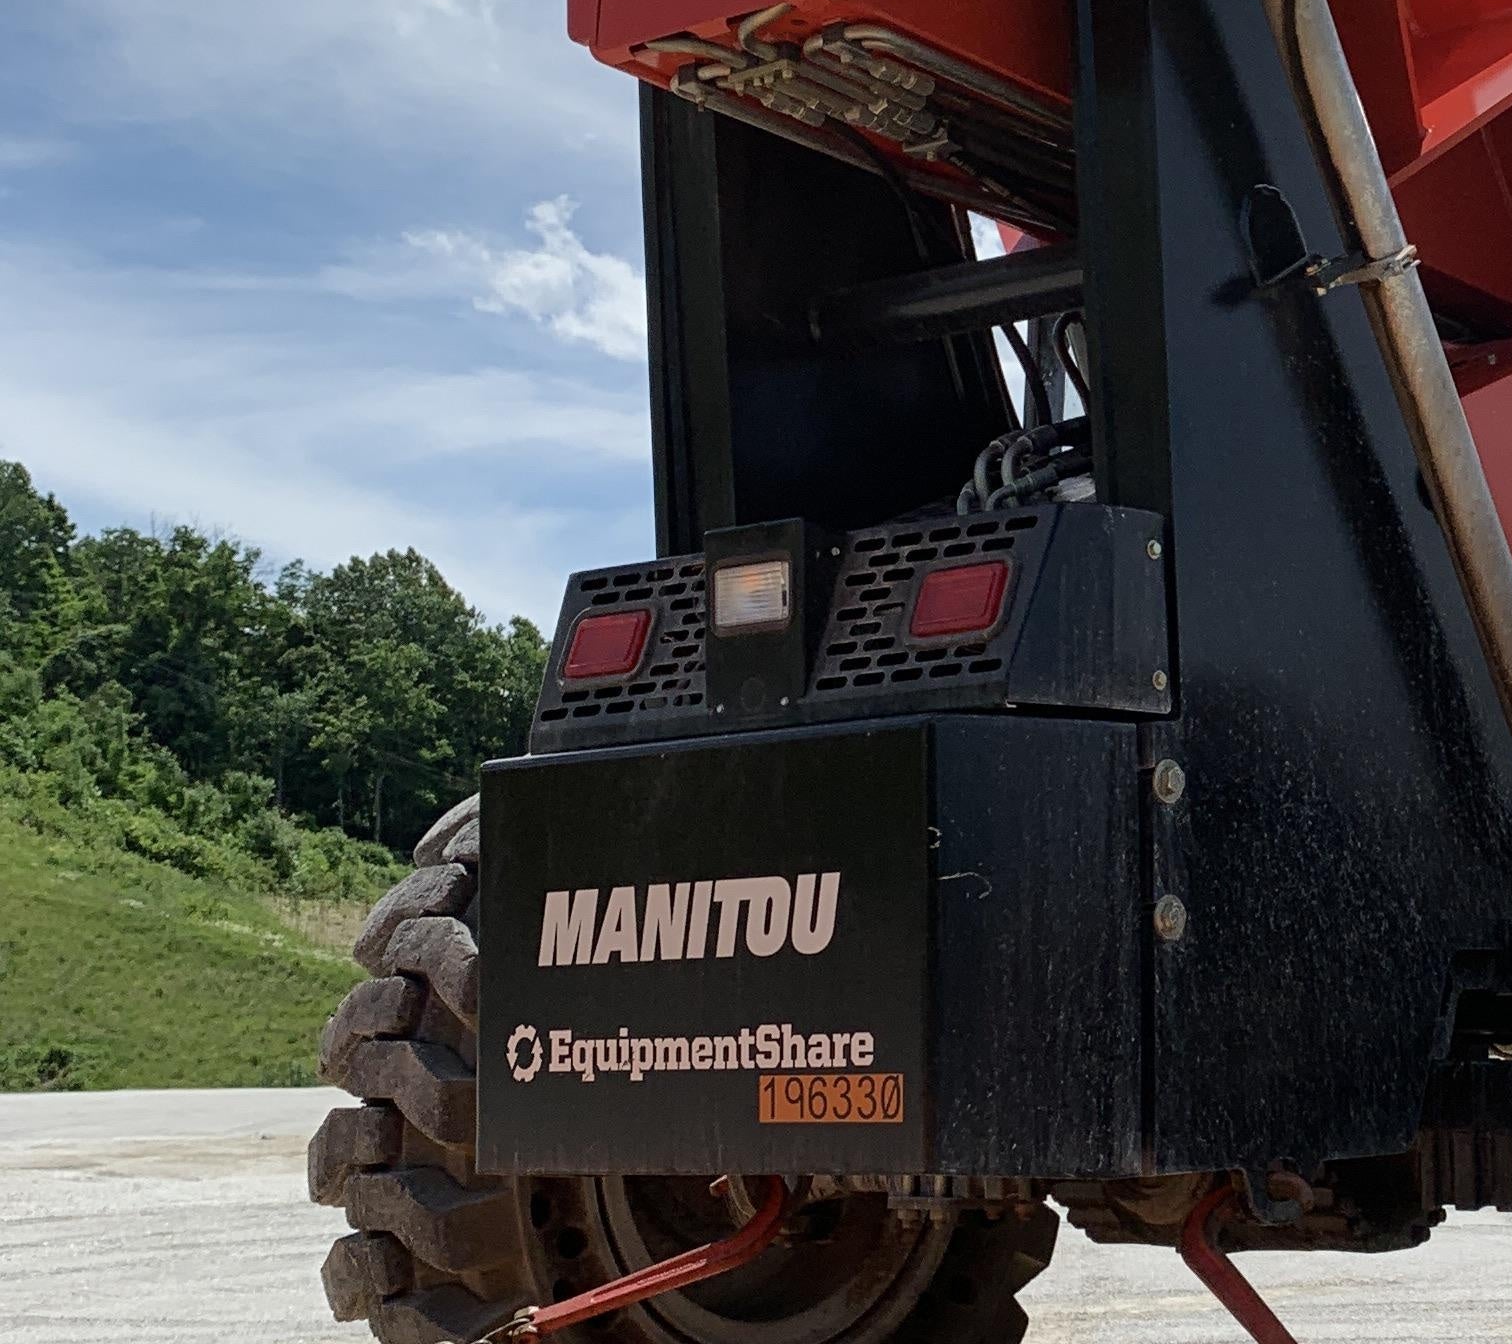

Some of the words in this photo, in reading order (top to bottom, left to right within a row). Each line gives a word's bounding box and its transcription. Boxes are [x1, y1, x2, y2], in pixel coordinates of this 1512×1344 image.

[537, 871, 841, 968] MANITOU
[548, 1024, 875, 1083] EquipmentShare
[762, 1075, 902, 1121] 196330
